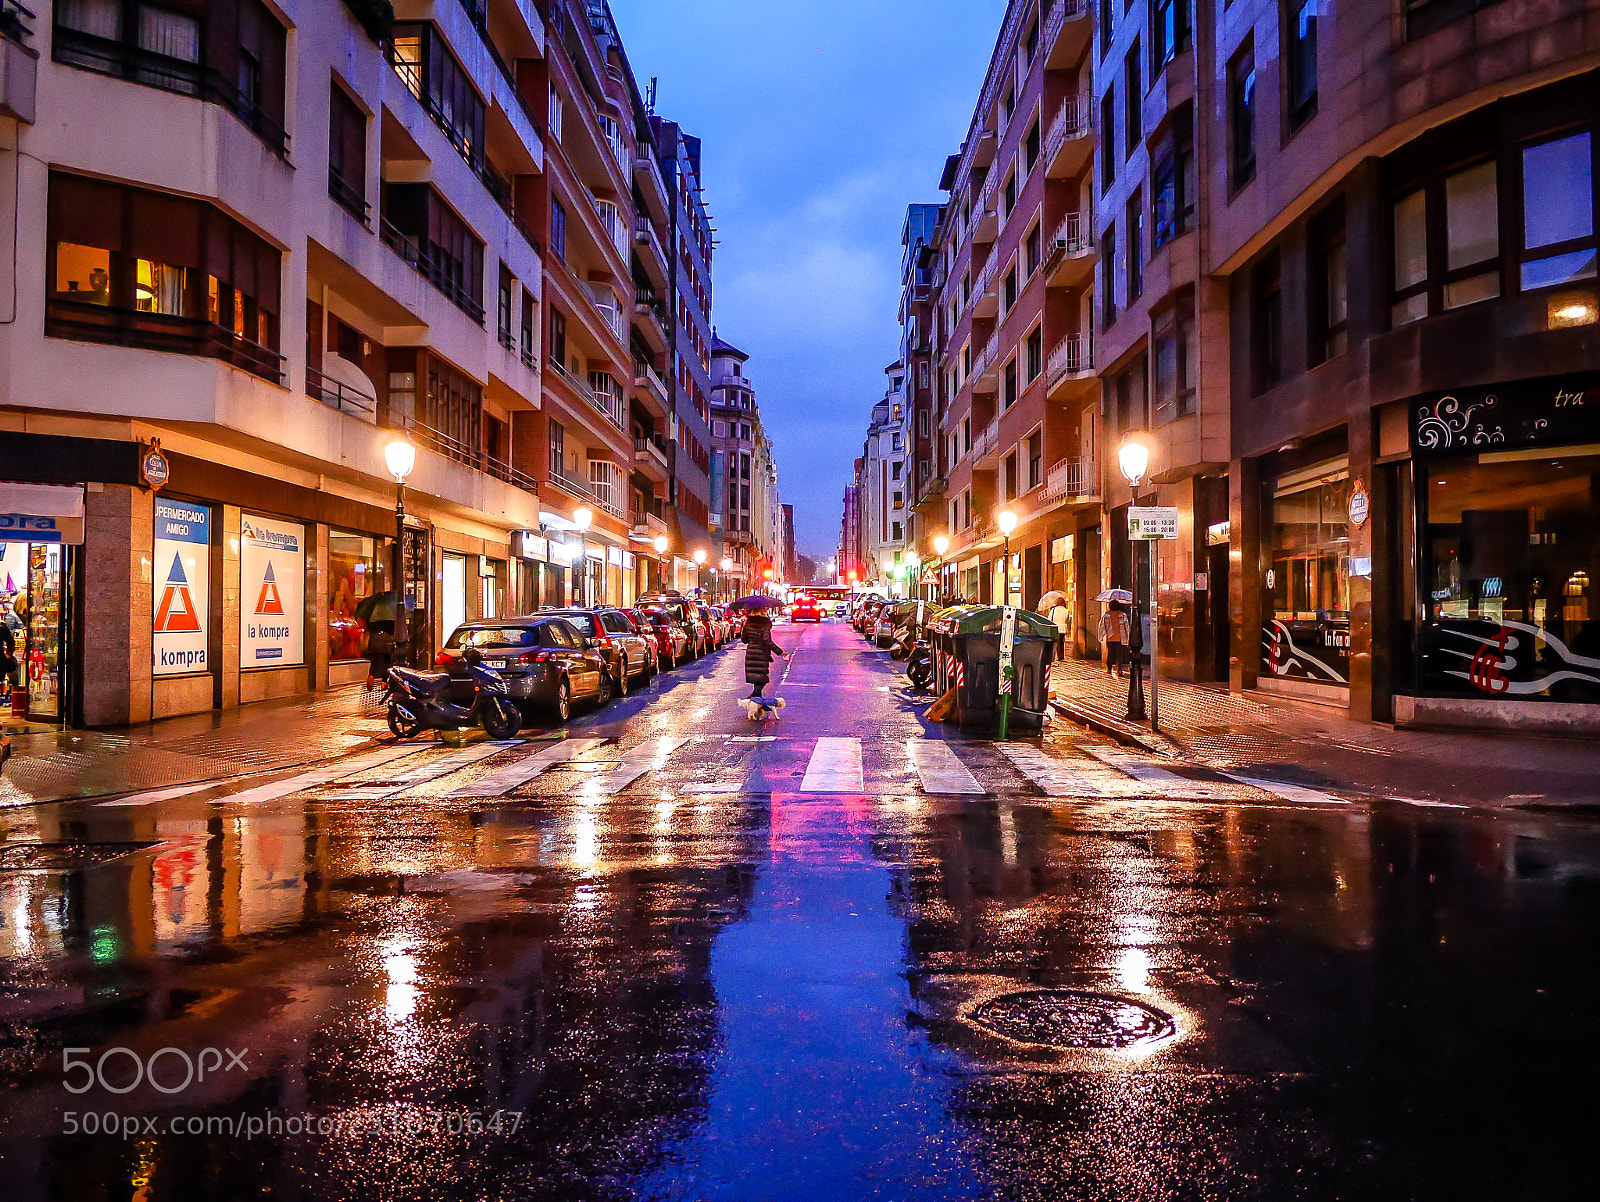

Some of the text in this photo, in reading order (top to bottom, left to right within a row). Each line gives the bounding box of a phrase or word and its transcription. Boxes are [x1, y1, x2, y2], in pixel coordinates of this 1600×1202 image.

[1554, 389, 1585, 408] tra
[165, 522, 189, 536] AMIGO
[255, 527, 265, 541] la
[265, 529, 298, 546] kompra
[247, 623, 290, 641] la kompra
[161, 647, 206, 668] kompra
